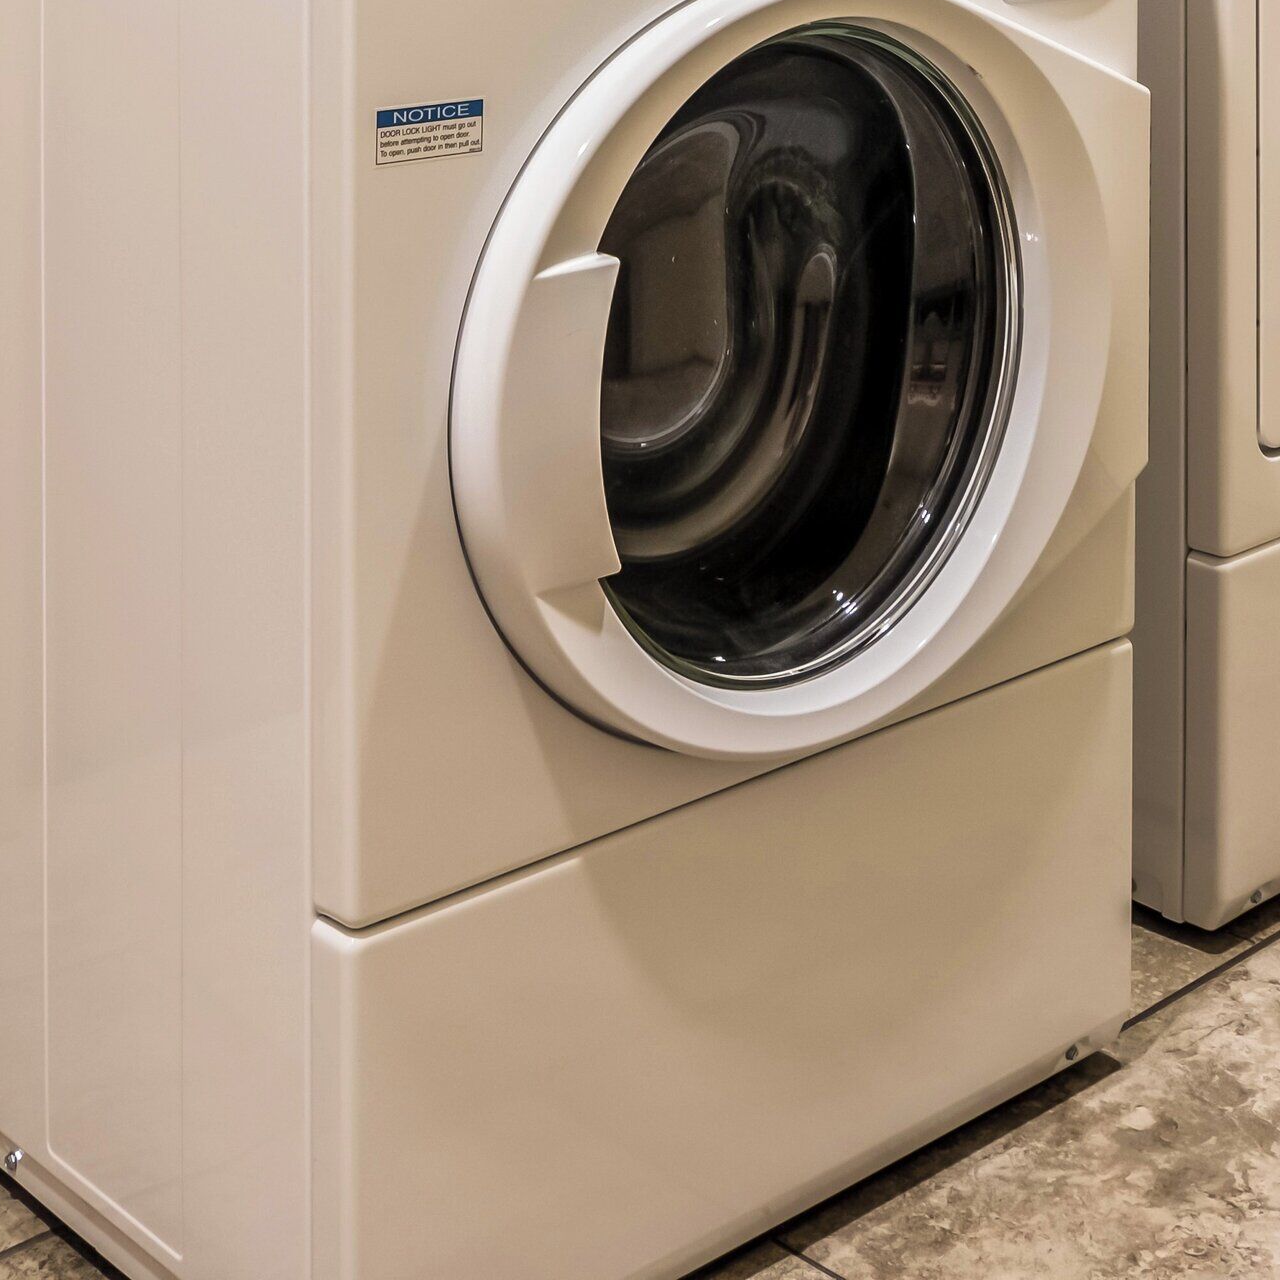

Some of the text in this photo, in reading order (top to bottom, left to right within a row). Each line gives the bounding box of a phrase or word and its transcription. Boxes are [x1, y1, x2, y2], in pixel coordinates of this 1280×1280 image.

[393, 103, 470, 124] NOTICE
[380, 120, 476, 138] DOOR LOCK LIGHT must go out
[380, 131, 470, 149] before attempting to open door.
[380, 150, 387, 158] To
[407, 146, 421, 156] push
[423, 143, 437, 152] door
[444, 141, 458, 149] then
[458, 140, 469, 149] pull
